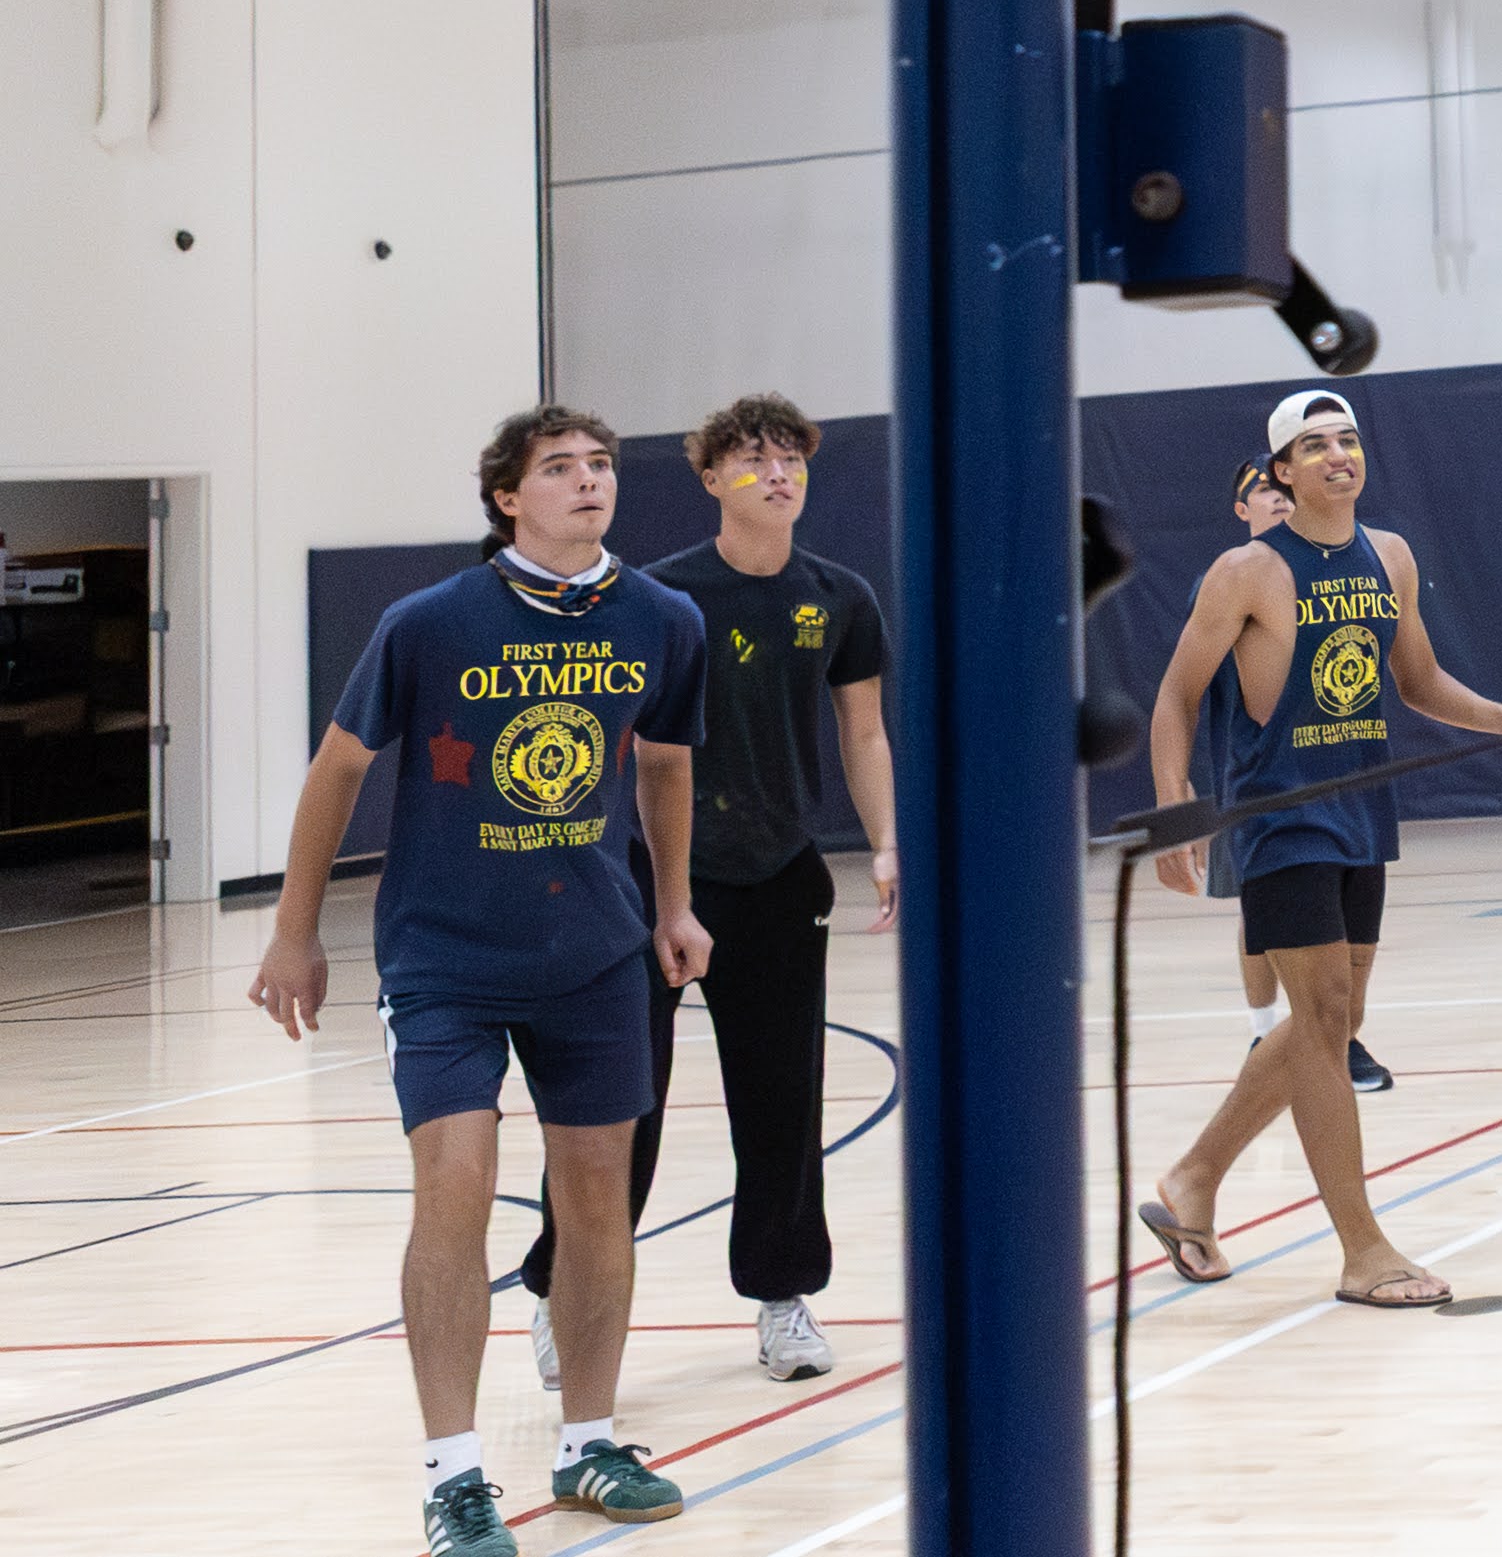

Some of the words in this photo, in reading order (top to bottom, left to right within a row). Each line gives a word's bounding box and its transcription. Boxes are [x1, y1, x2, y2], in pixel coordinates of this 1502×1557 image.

[1311, 578, 1346, 595] FIRST
[1348, 576, 1379, 590] YEAR
[502, 643, 557, 661] FIRST
[562, 641, 613, 659] YEAR
[460, 661, 647, 700] OLYMPICS
[518, 823, 546, 839] DAY
[549, 823, 561, 835] IS
[480, 838, 488, 849] A
